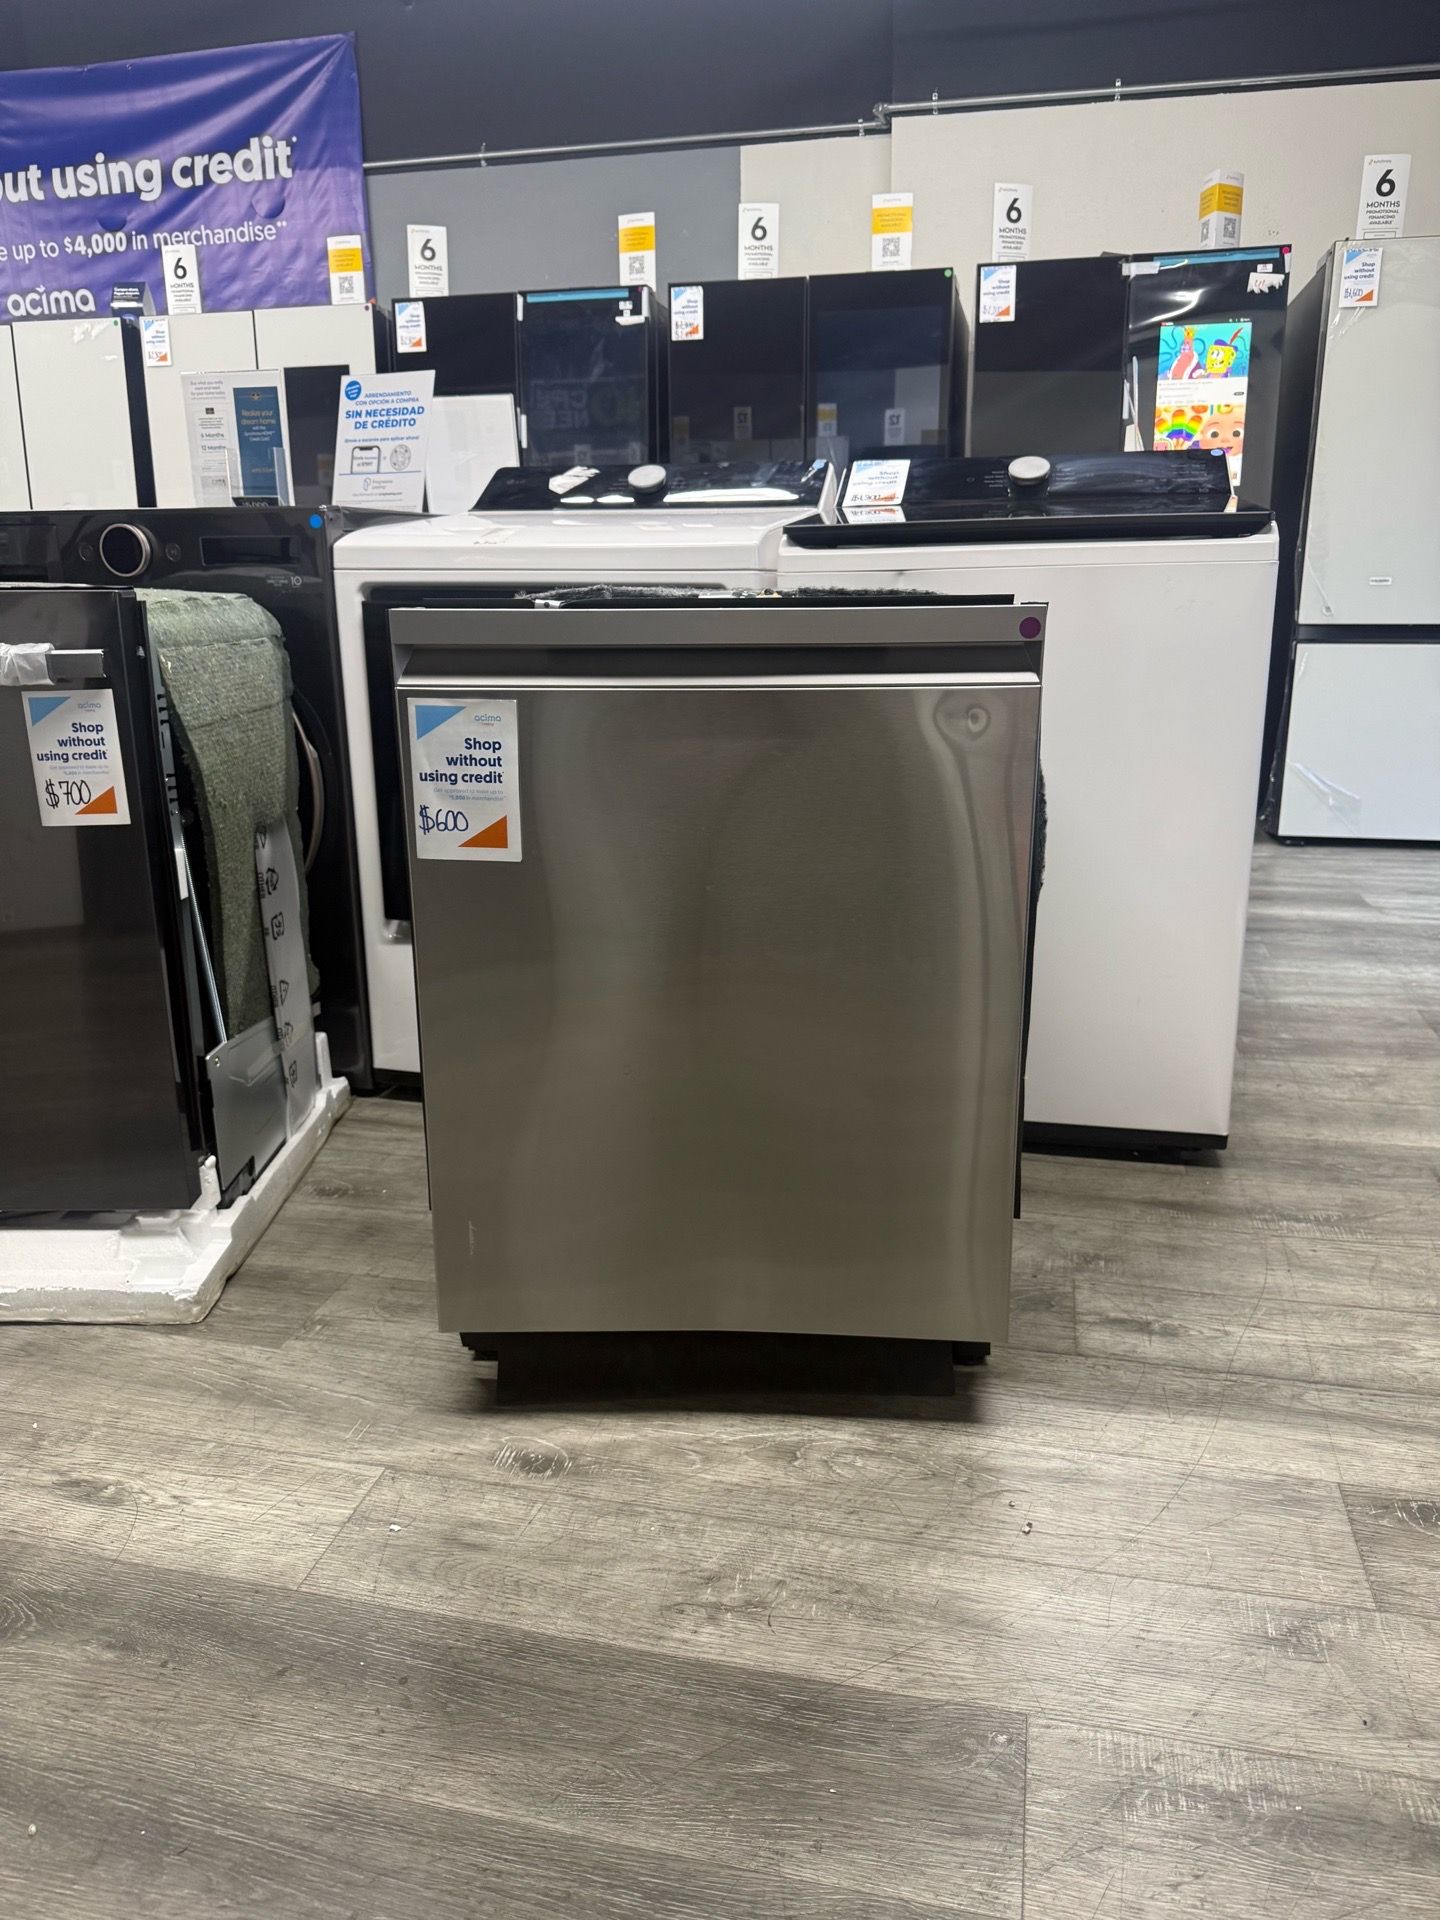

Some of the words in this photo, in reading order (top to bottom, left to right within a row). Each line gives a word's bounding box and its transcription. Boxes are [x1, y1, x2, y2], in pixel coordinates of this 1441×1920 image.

[0, 164, 45, 203] ut
[52, 152, 162, 201] using
[1376, 168, 1396, 197] 6
[1006, 197, 1022, 224] 6
[751, 216, 767, 241] 6
[999, 227, 1027, 235] MONTHS
[13, 244, 36, 264] up
[39, 239, 60, 258] to
[63, 231, 128, 258] $4,000
[131, 230, 149, 250] in
[420, 238, 436, 261] 6
[173, 257, 188, 280] 6
[345, 410, 362, 419] SIN
[365, 406, 425, 418] NECESIDAD
[354, 421, 368, 430] DE
[371, 417, 417, 429] CRÉDITO
[71, 722, 104, 735] Shop
[57, 736, 106, 748] without
[464, 737, 502, 753] Shop
[36, 750, 69, 763] using
[446, 754, 503, 767] without
[419, 769, 458, 785] using
[45, 778, 92, 810] $700
[418, 804, 469, 836] $600
